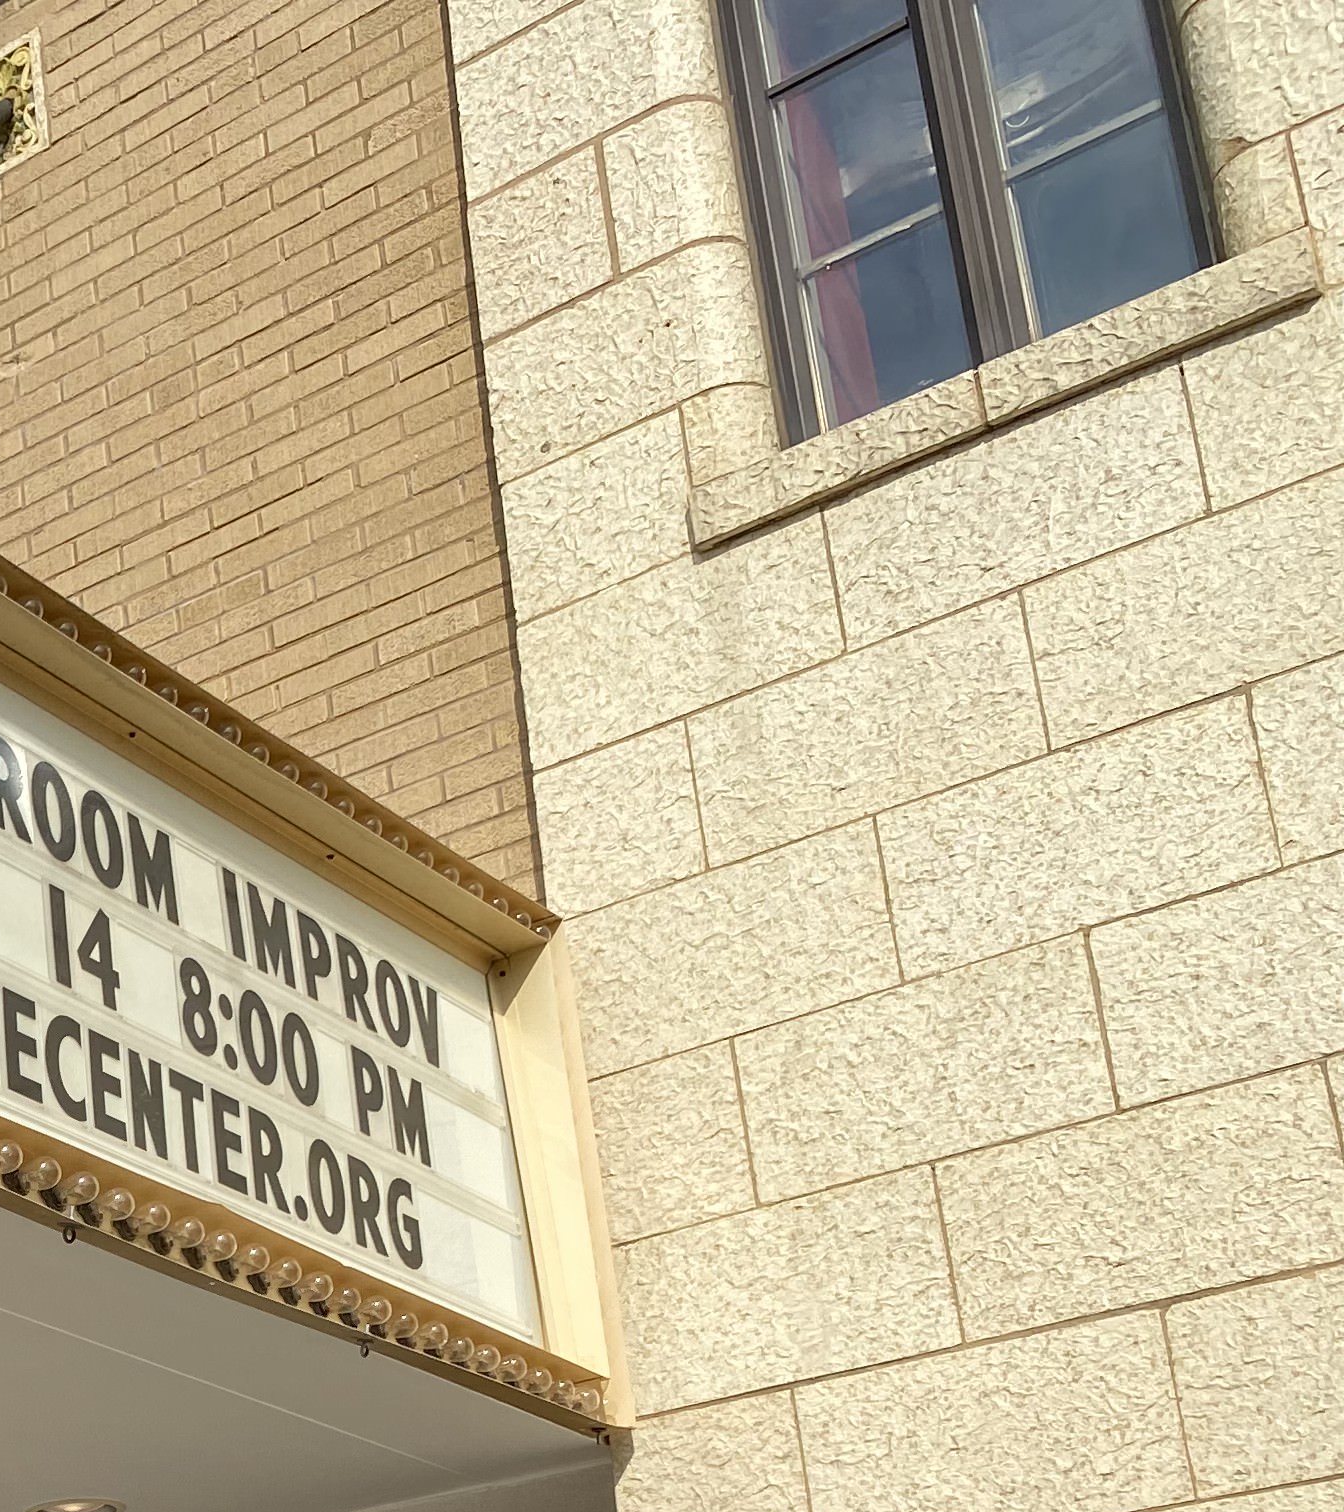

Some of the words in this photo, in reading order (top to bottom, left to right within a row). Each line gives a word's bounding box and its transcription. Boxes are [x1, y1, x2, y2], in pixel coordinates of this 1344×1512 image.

[48, 886, 122, 1012] 14
[178, 956, 320, 1108] 8:00
[350, 1044, 432, 1169] PM
[220, 866, 442, 1066] IMPROV
